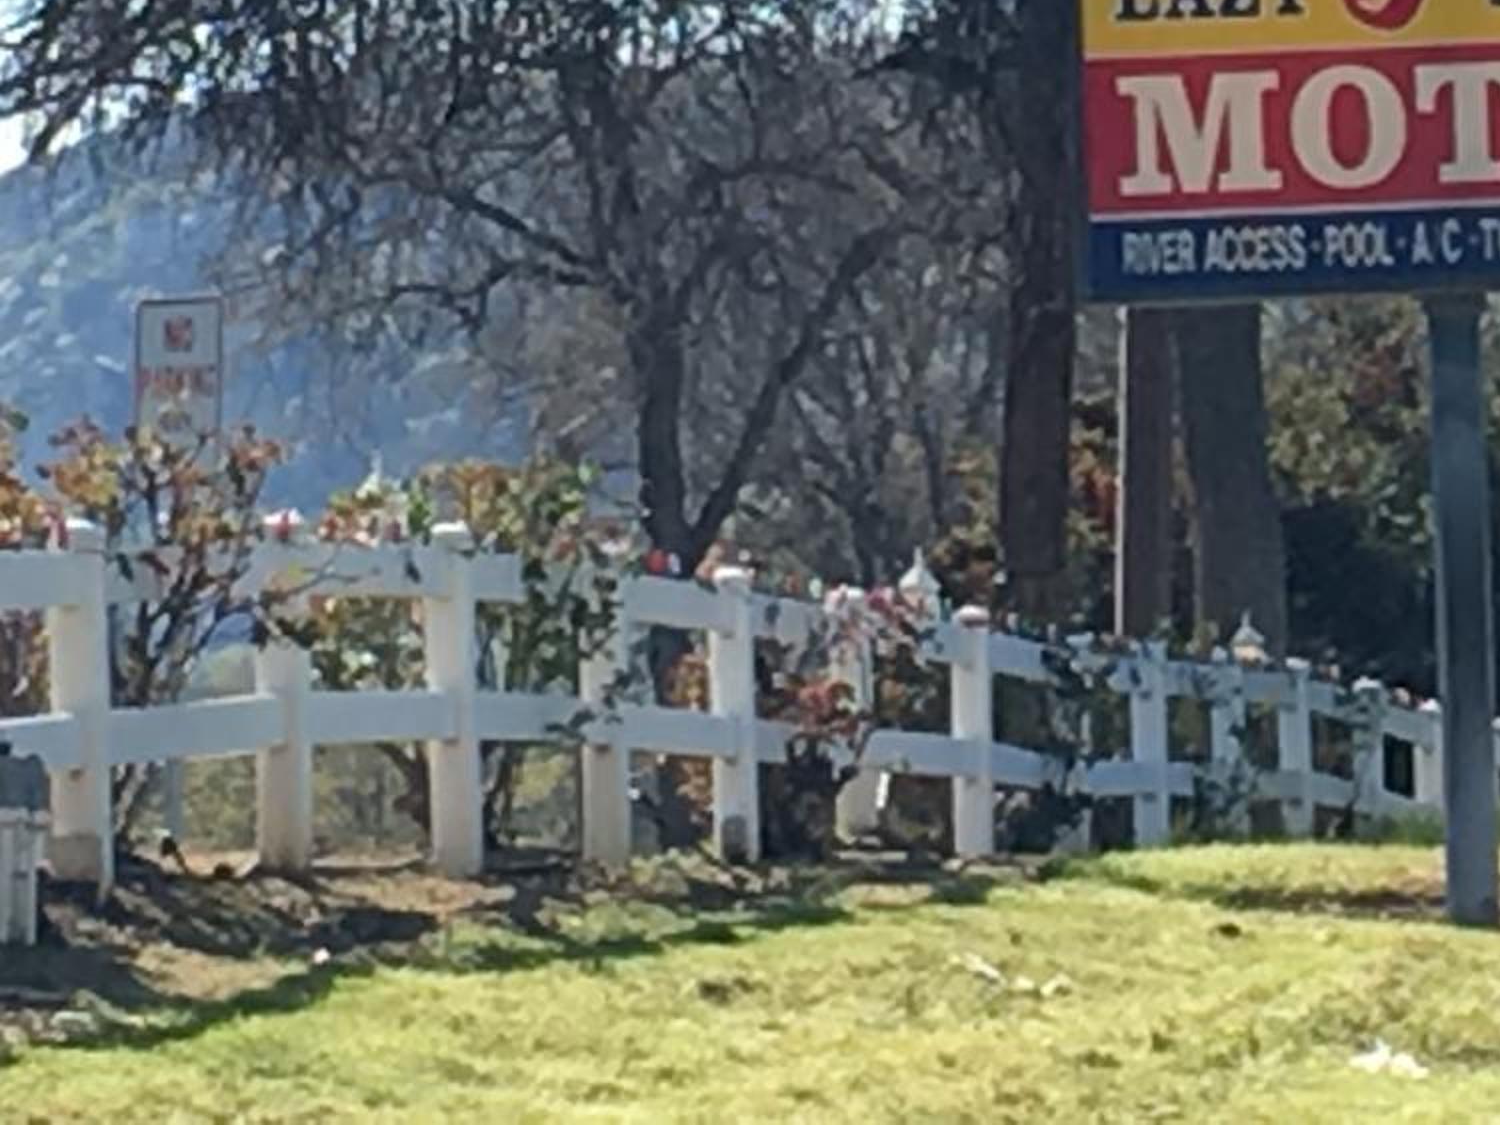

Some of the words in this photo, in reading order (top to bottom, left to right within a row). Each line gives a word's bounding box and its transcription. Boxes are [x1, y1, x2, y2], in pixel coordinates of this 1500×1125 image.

[1122, 228, 1196, 274] RIVER
[1203, 224, 1307, 272] ACCESS
[1324, 221, 1395, 267] POOL
